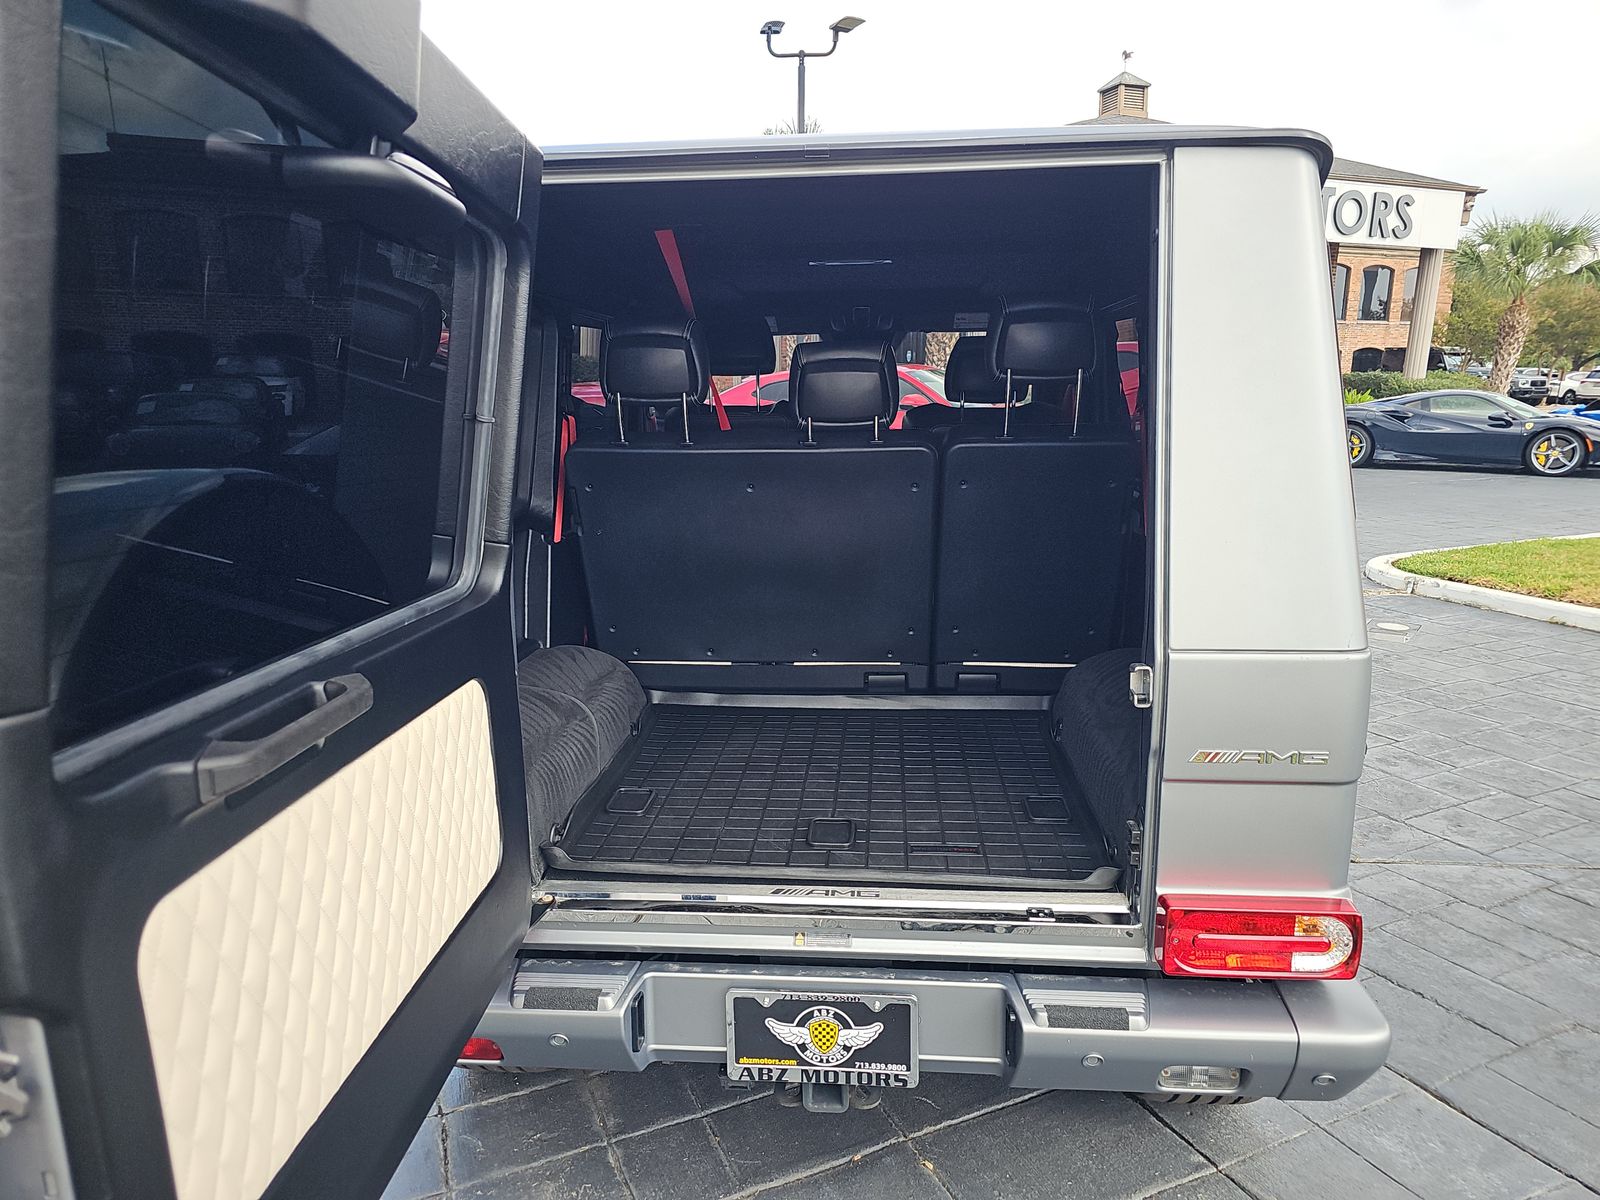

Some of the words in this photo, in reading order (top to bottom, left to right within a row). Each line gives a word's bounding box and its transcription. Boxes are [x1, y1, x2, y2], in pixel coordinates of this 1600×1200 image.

[1231, 750, 1329, 765] AMG
[804, 888, 880, 898] AMG
[813, 1009, 835, 1018] ABZ
[803, 1049, 848, 1063] MOTORS
[739, 1057, 797, 1066] abzmotors.com
[855, 1062, 907, 1071] 713.839.9800
[739, 1067, 789, 1082] ABZ
[801, 1069, 908, 1088] MOTORS
